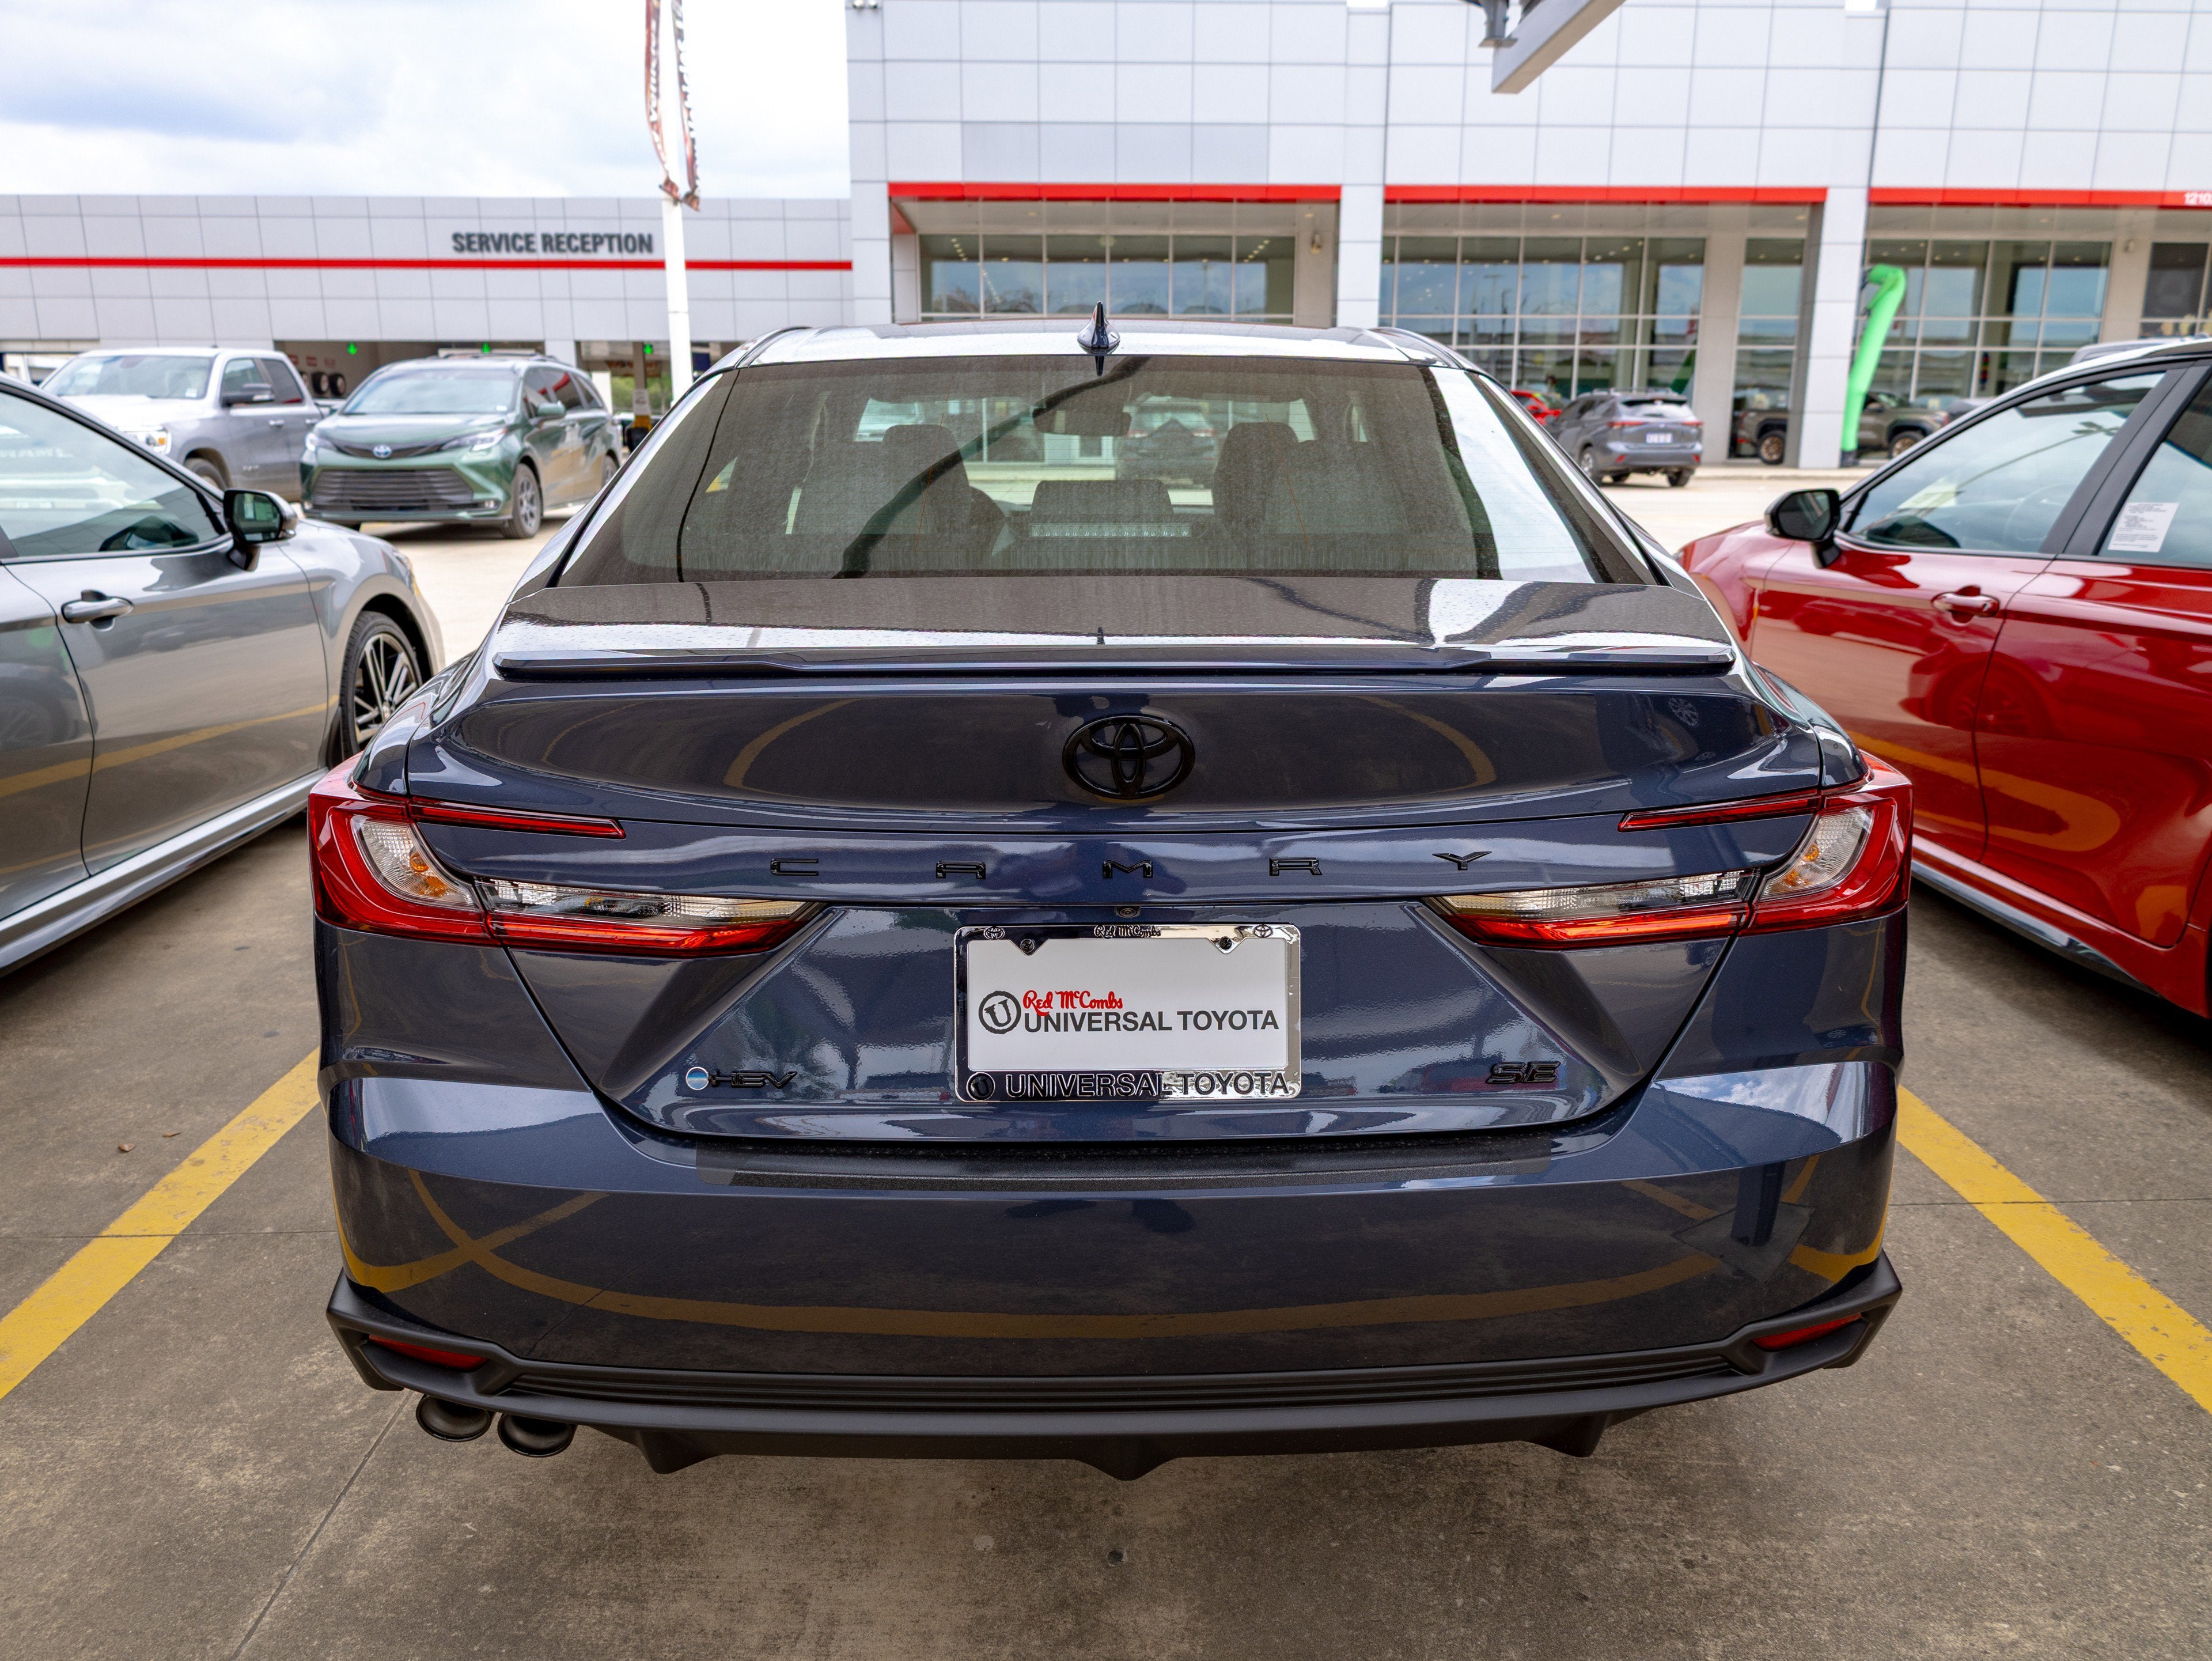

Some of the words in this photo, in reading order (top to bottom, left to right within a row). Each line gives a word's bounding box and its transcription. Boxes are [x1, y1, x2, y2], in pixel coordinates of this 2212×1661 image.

[2184, 192, 2212, 205] 1210
[452, 233, 536, 253] SERVICE
[541, 233, 653, 253] RECEPTION
[770, 850, 1492, 880] CAMRY
[1094, 924, 1116, 939] Red
[1022, 990, 1053, 1016] Red
[1055, 990, 1123, 1009] McCombs
[1024, 1011, 1172, 1032] UNIVERSAL
[1177, 1010, 1279, 1031] TOYOTA
[1486, 1061, 1561, 1084] SE
[1006, 1072, 1173, 1098] UNIVERSAL
[1176, 1072, 1290, 1095] TOYOTA
